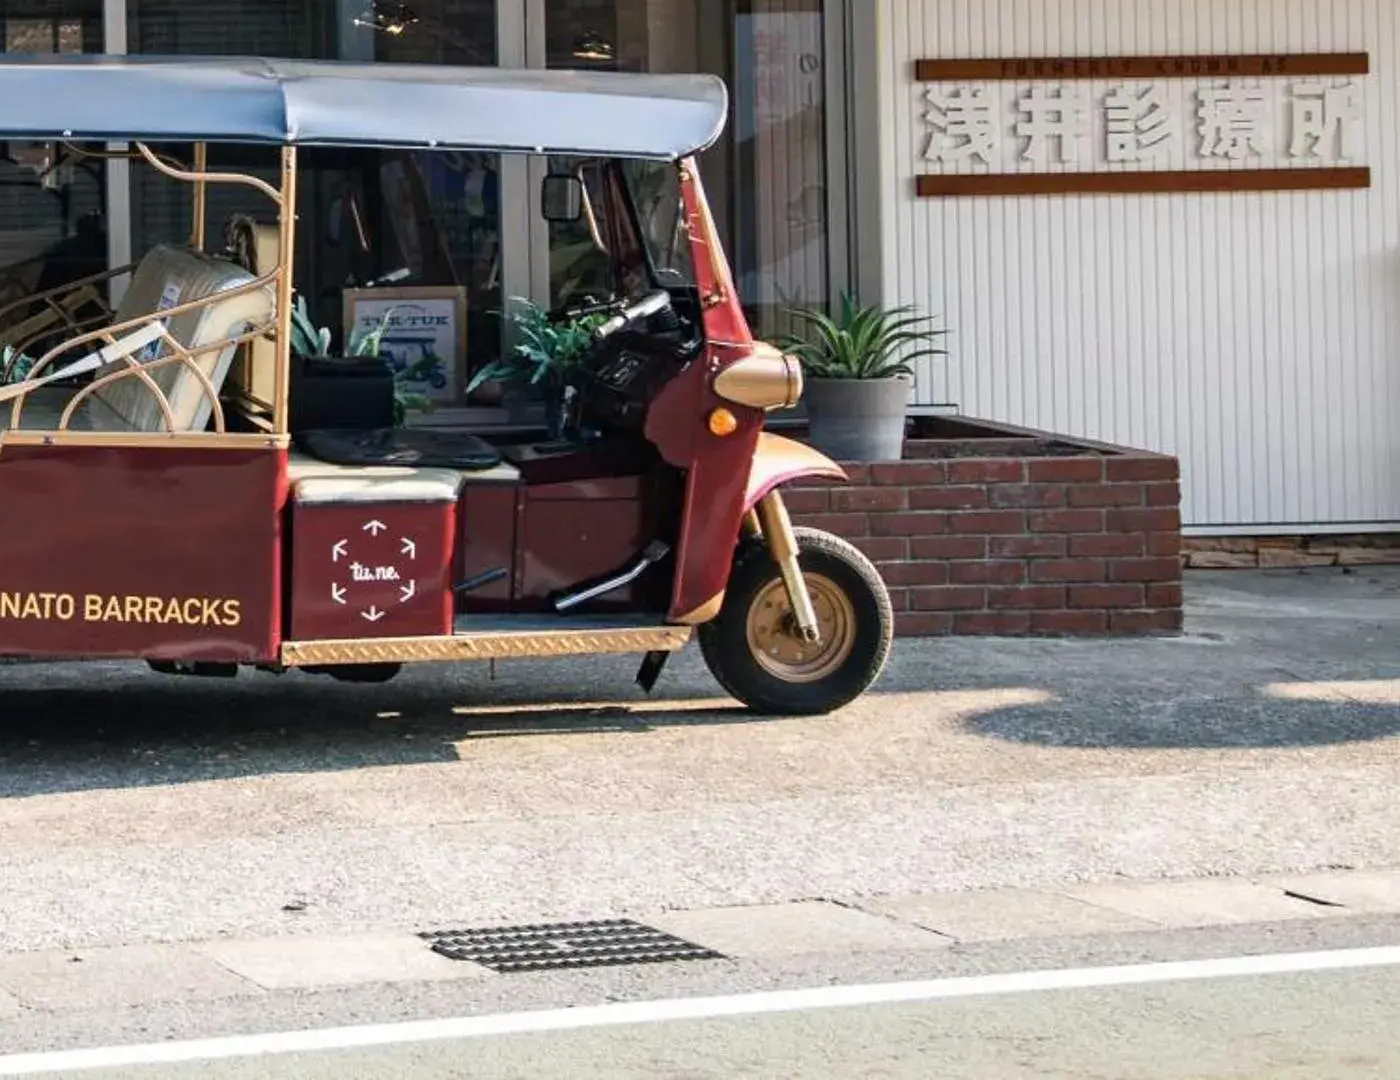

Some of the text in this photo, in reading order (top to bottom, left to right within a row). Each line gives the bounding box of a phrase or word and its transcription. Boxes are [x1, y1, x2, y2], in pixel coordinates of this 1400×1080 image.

[1000, 56, 1287, 77] FORMERLY KNOWN AS
[920, 82, 1365, 163] 浅井診療所
[84, 594, 241, 626] BARRACKS
